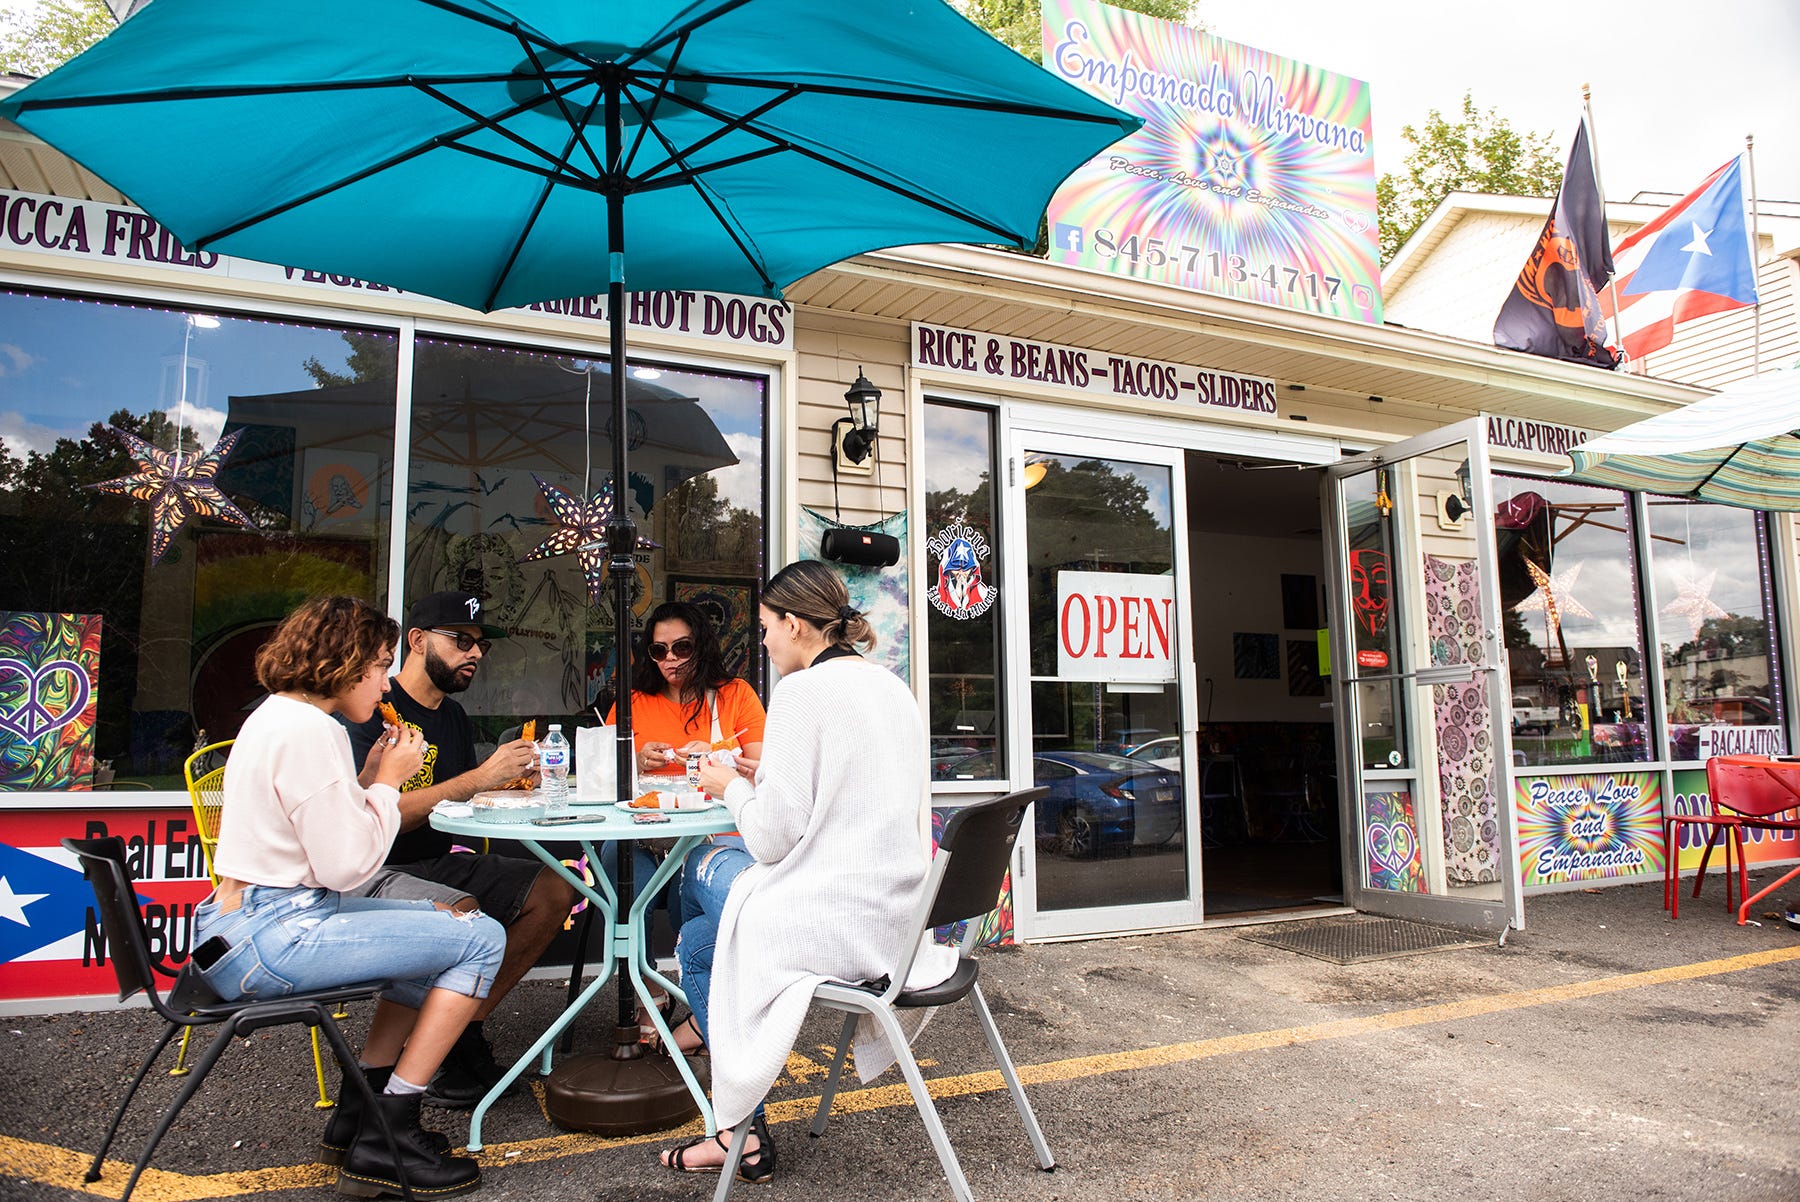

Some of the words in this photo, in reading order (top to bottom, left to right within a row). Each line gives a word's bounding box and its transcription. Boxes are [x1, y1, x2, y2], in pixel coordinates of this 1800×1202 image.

[1055, 21, 1234, 118] Empanada
[1243, 70, 1365, 154] Nirvana
[1168, 171, 1208, 189] Love
[1211, 183, 1241, 198] and
[1246, 189, 1329, 219] Empanadas
[0, 195, 91, 253] CCA
[1094, 229, 1342, 302] 845-713-4717
[629, 290, 695, 333] HOT
[703, 295, 785, 345] DOGS
[918, 326, 978, 372] RICE
[984, 338, 1005, 376] &
[1487, 416, 1588, 456] ALCAPURRIAS
[926, 517, 991, 560] Boricua
[1061, 592, 1172, 661] OPEN
[1596, 779, 1640, 801] Love
[1571, 814, 1607, 835] and
[1537, 844, 1645, 875] Empanadas
[145, 904, 197, 963] BU
